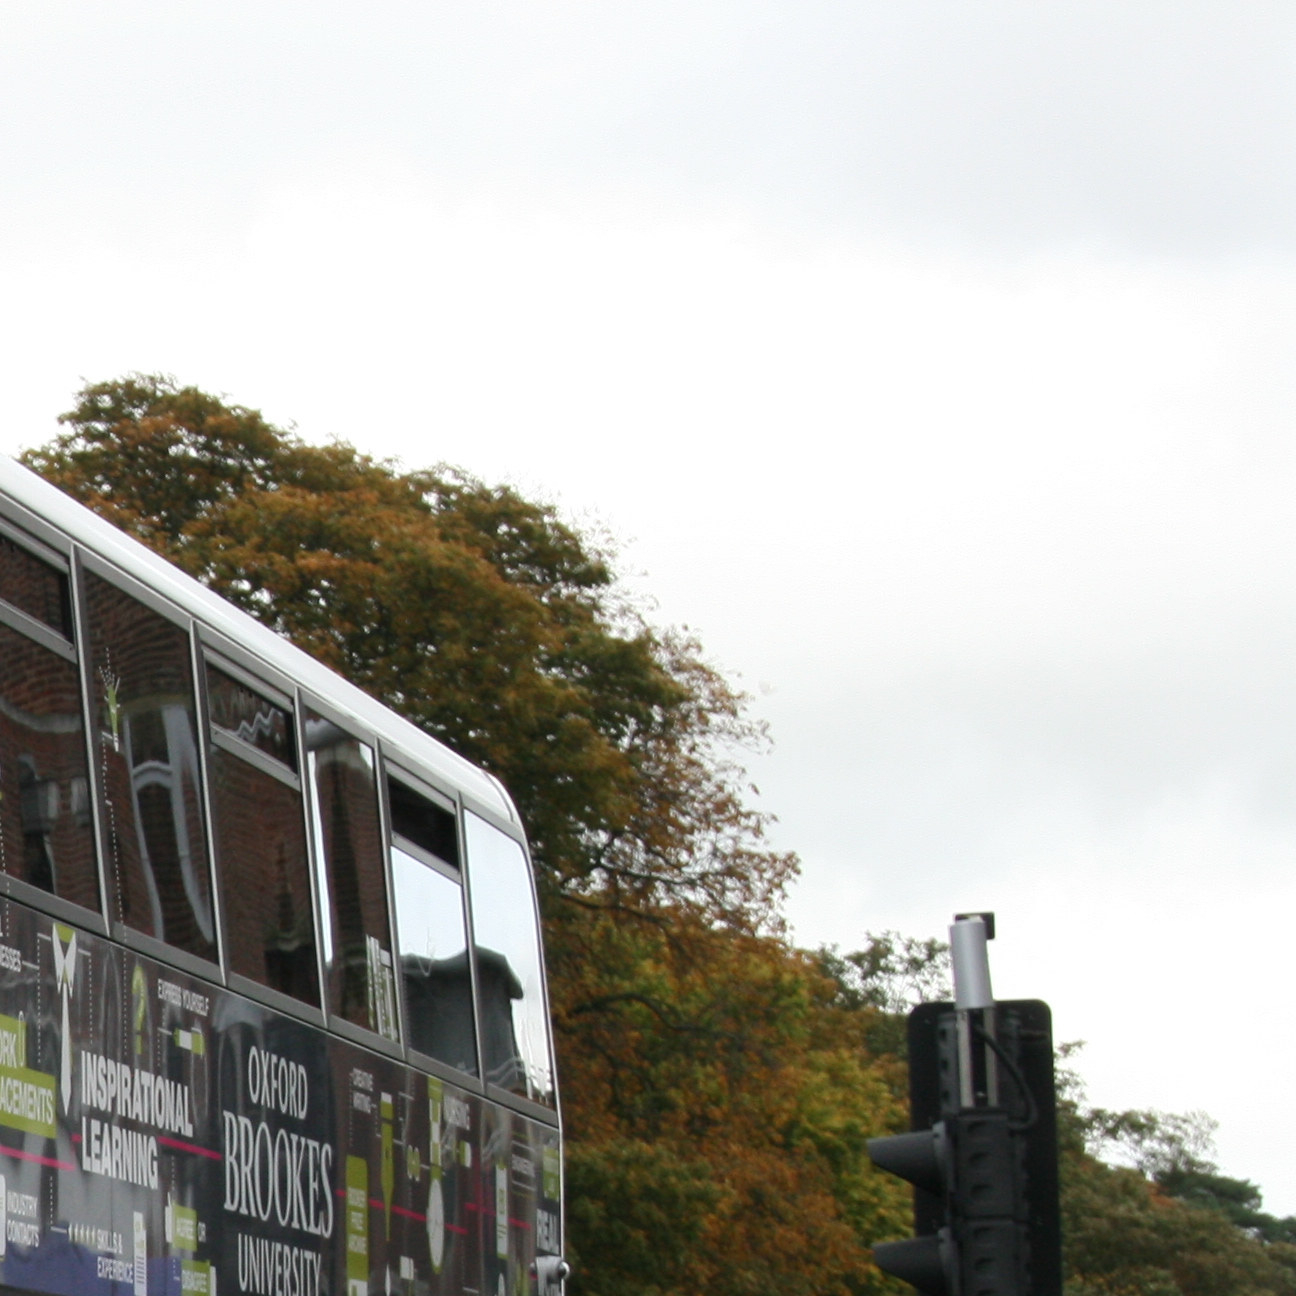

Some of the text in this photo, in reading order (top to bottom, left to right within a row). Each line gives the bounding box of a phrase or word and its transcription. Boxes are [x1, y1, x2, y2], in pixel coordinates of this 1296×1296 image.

[81, 1050, 194, 1138] INSPIRATIONAL
[248, 1045, 308, 1120] OXFORD
[81, 1116, 159, 1190] LEARNING
[223, 1109, 335, 1239] BROOKES
[7, 1191, 38, 1219] INDUSTRY
[7, 1219, 40, 1248] CONTACTS
[97, 1228, 117, 1253] SKILLS
[97, 1256, 134, 1284] EXPERIENCE
